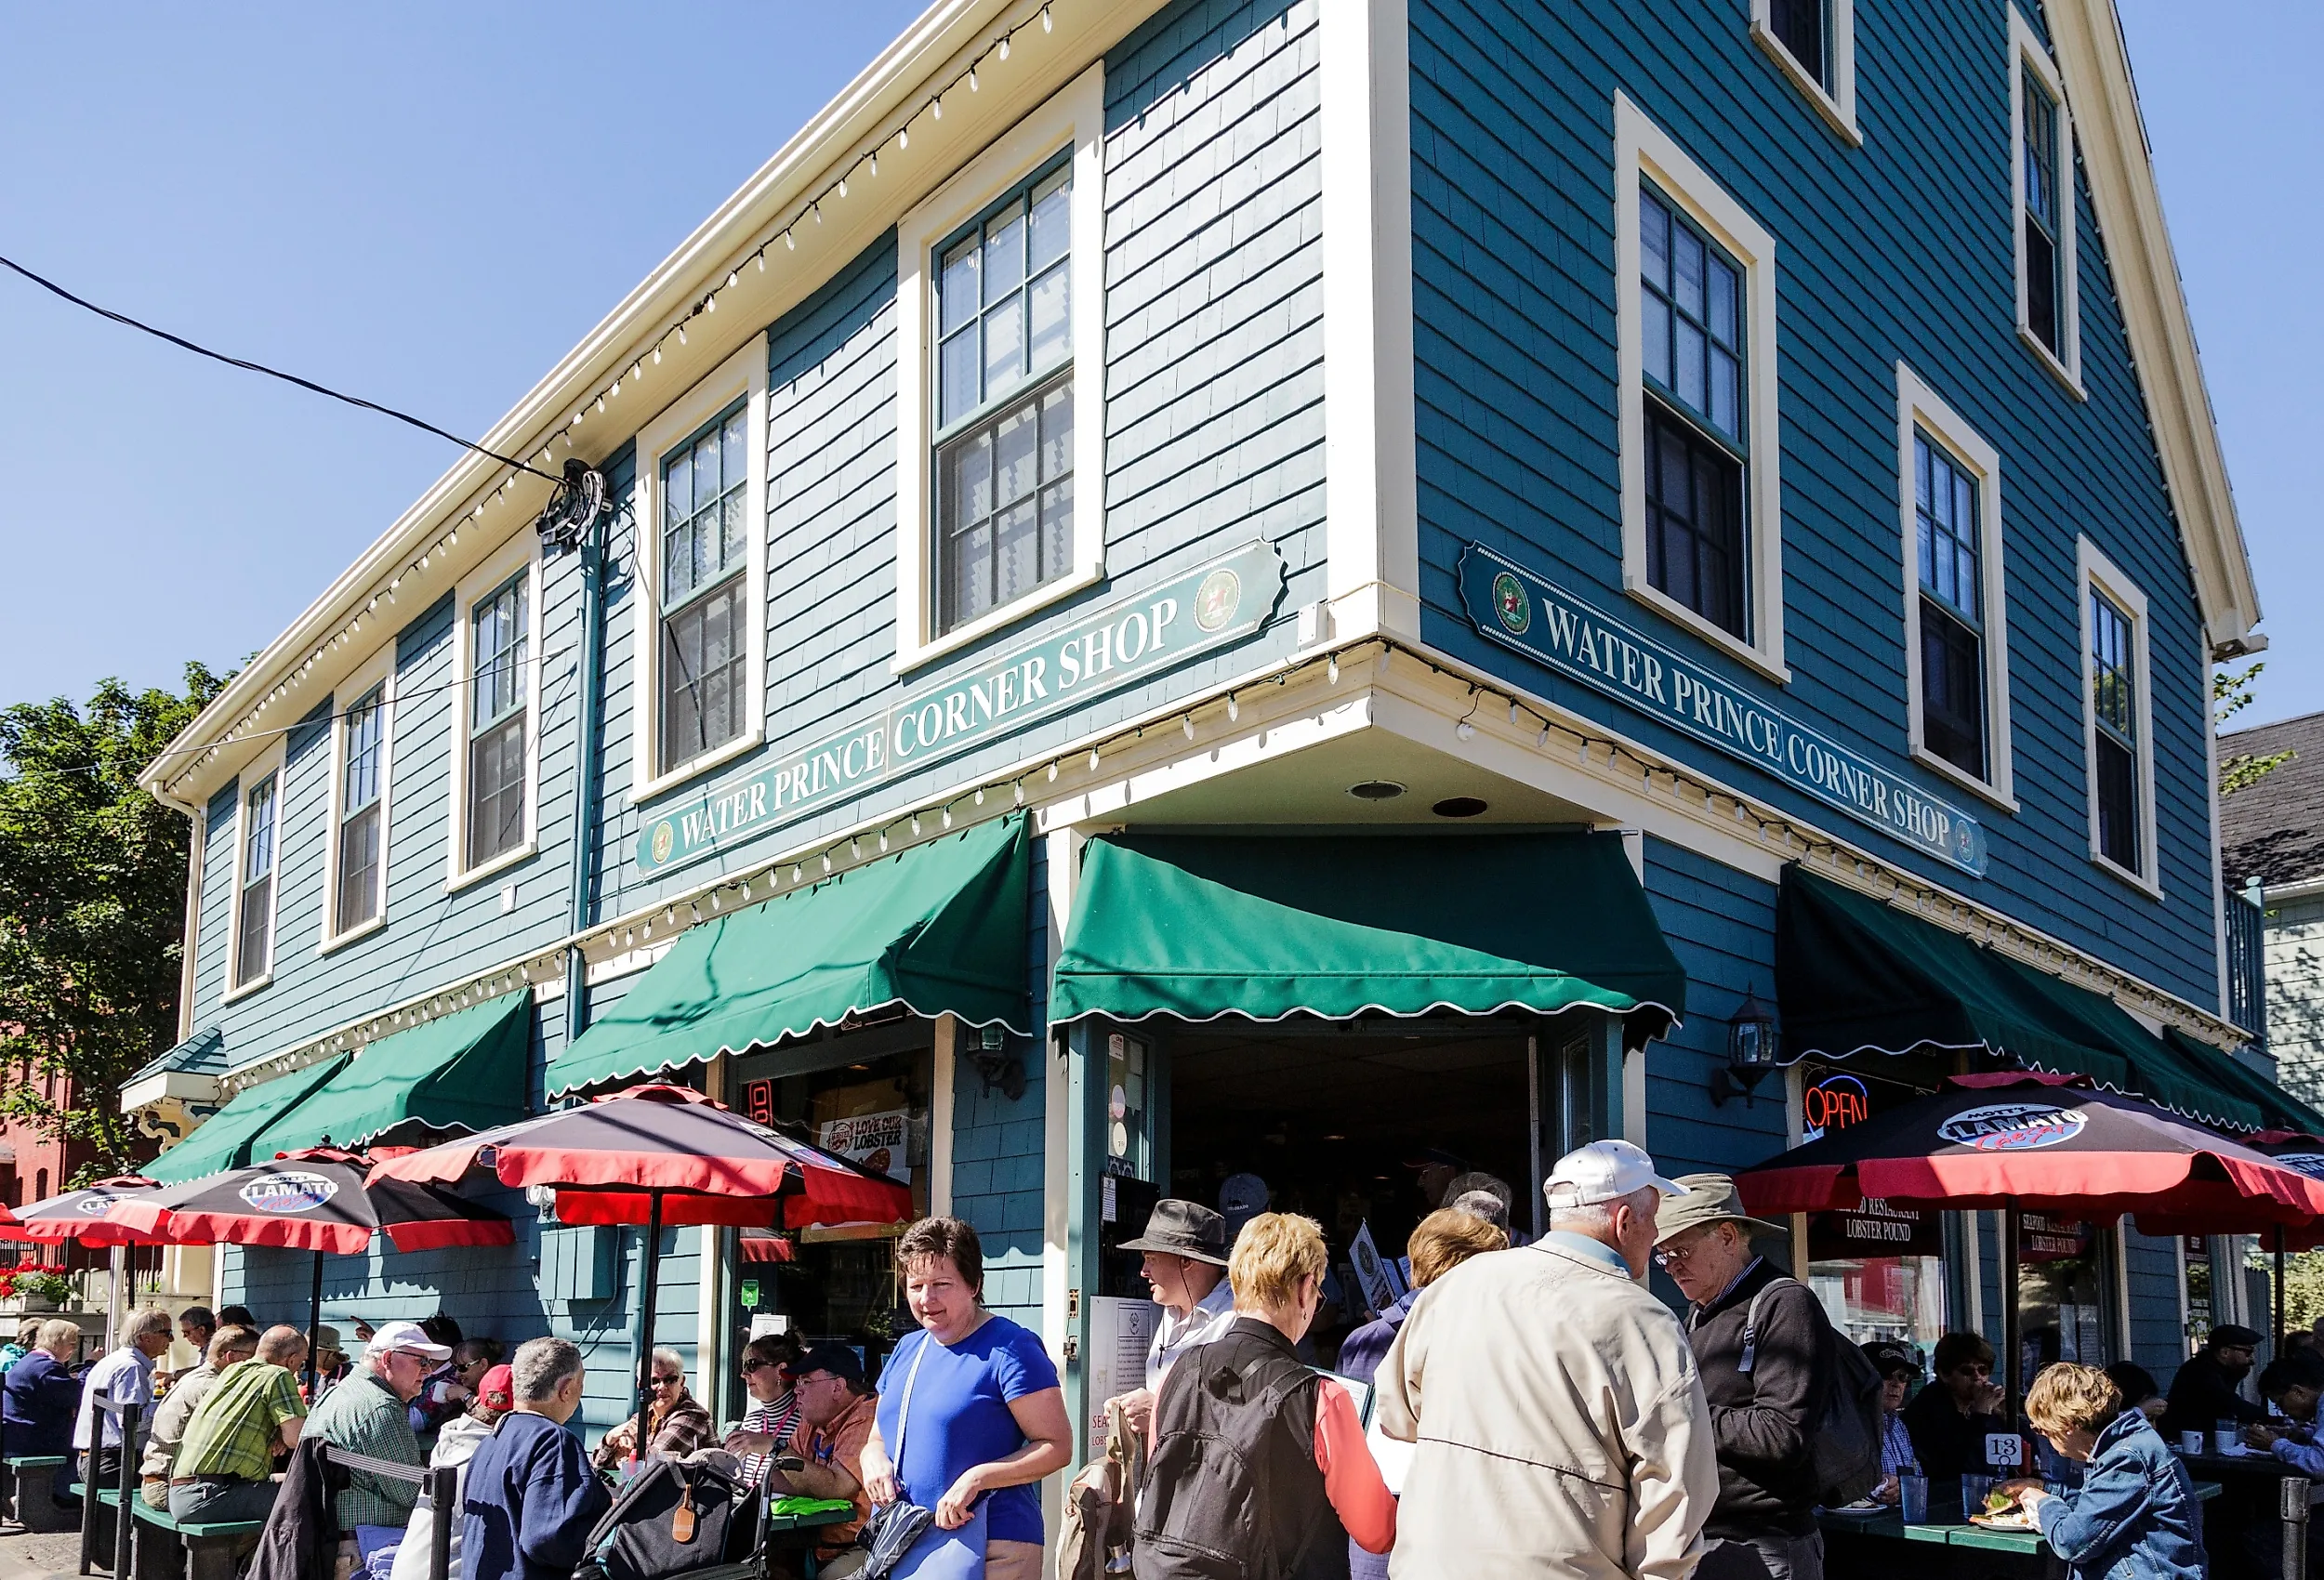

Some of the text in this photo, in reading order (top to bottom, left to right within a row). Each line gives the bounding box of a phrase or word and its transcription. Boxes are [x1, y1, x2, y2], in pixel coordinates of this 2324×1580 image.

[680, 782, 767, 849] WATER
[773, 727, 886, 811] PRINCE
[893, 656, 1050, 757] CORNER
[1058, 598, 1179, 692] SHOP
[1542, 597, 1667, 705] WATER
[1671, 667, 1783, 763] PRINCE
[1788, 733, 1890, 820] CORNER
[1894, 789, 1949, 848] SHOP
[1805, 1086, 1868, 1128] OPEN
[1967, 1106, 2028, 1119] MOTT'S
[855, 1115, 903, 1135] LOVE OUR
[1937, 1109, 2089, 1140] CLAMATO
[853, 1130, 902, 1151] LOBSTER
[1974, 1123, 2077, 1152] Caesar
[239, 1181, 339, 1199] CLAMATO
[1846, 1218, 1910, 1242] LOBSTER POUND
[1990, 1438, 2017, 1456] 13
